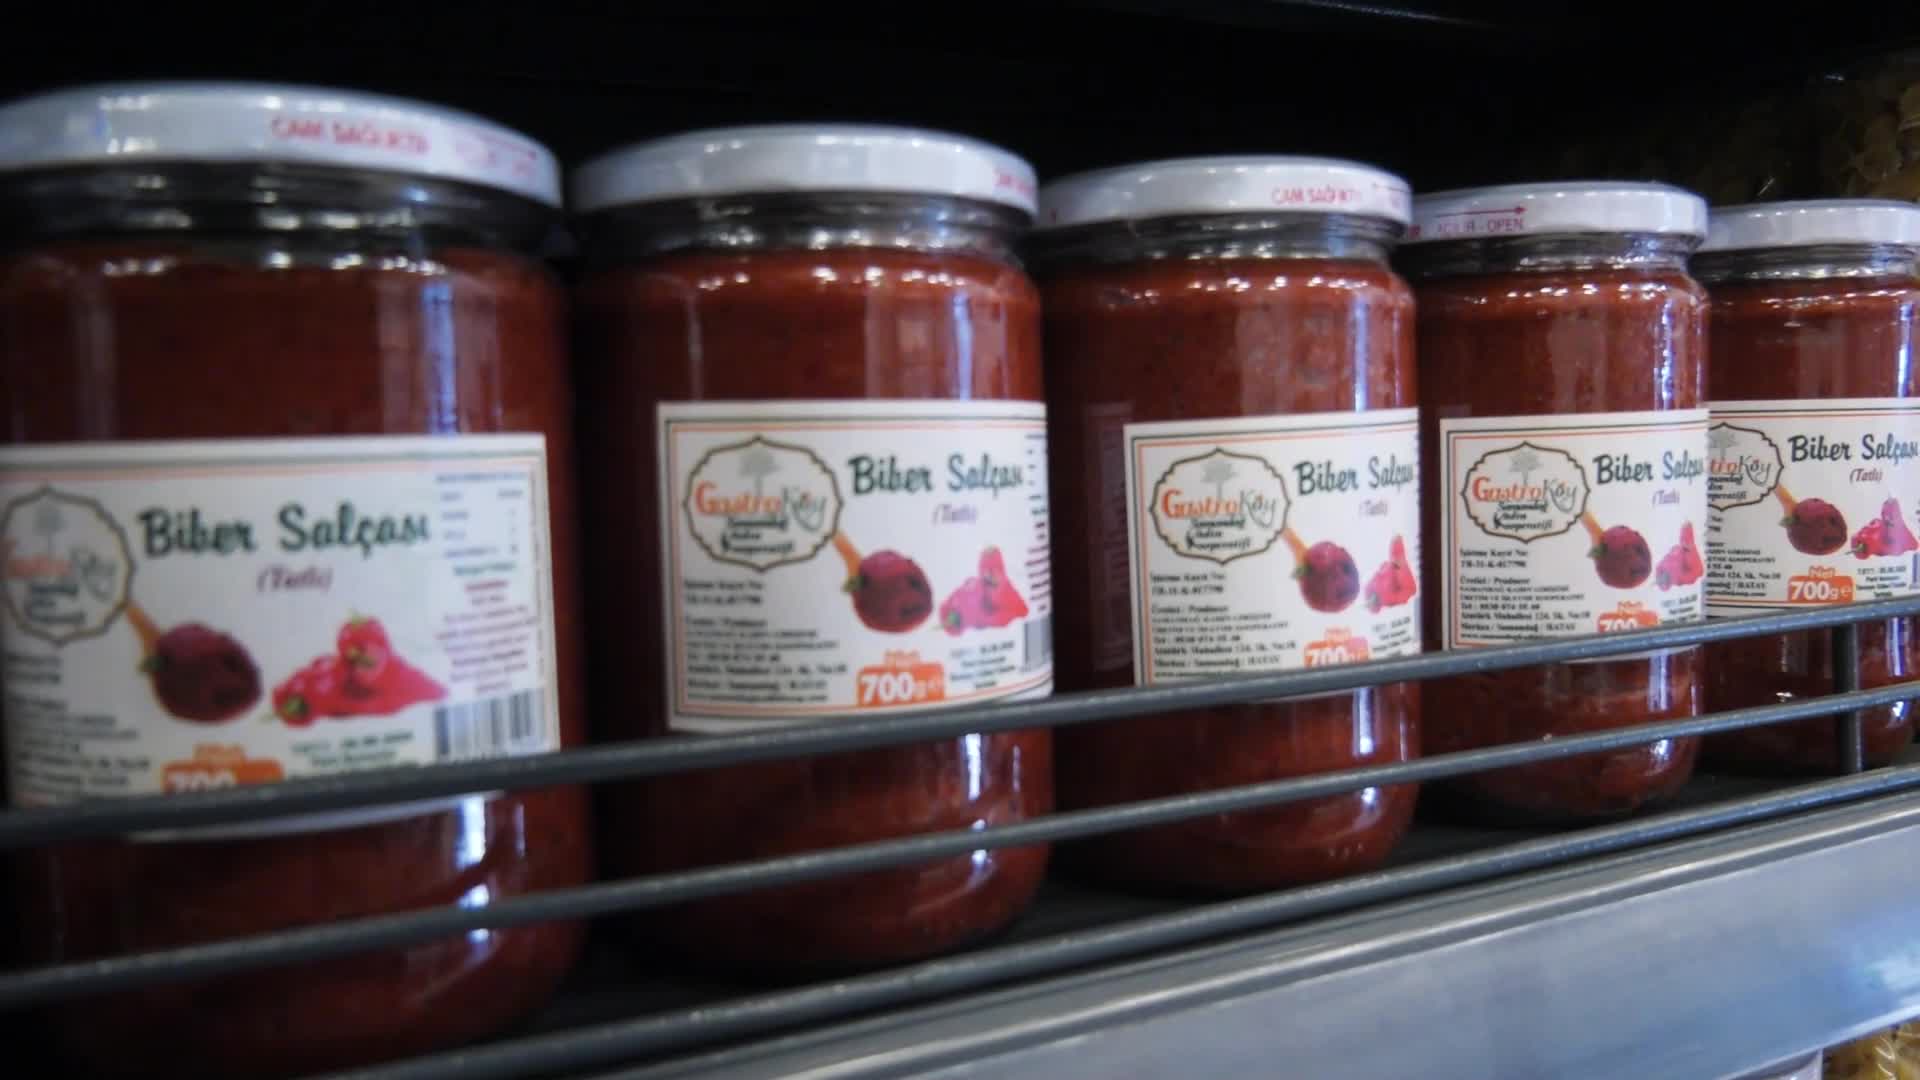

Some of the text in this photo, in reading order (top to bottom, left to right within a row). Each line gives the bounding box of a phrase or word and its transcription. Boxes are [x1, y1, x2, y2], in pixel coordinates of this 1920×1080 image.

[1487, 217, 1525, 232] OPEN
[1787, 434, 1852, 462] Biber
[848, 454, 933, 495] Biber
[1293, 459, 1359, 496] Biber
[1592, 453, 1654, 486] Biber
[1472, 476, 1578, 513] GastroKöy
[139, 508, 258, 557] Biber
[277, 502, 430, 558] Salçası
